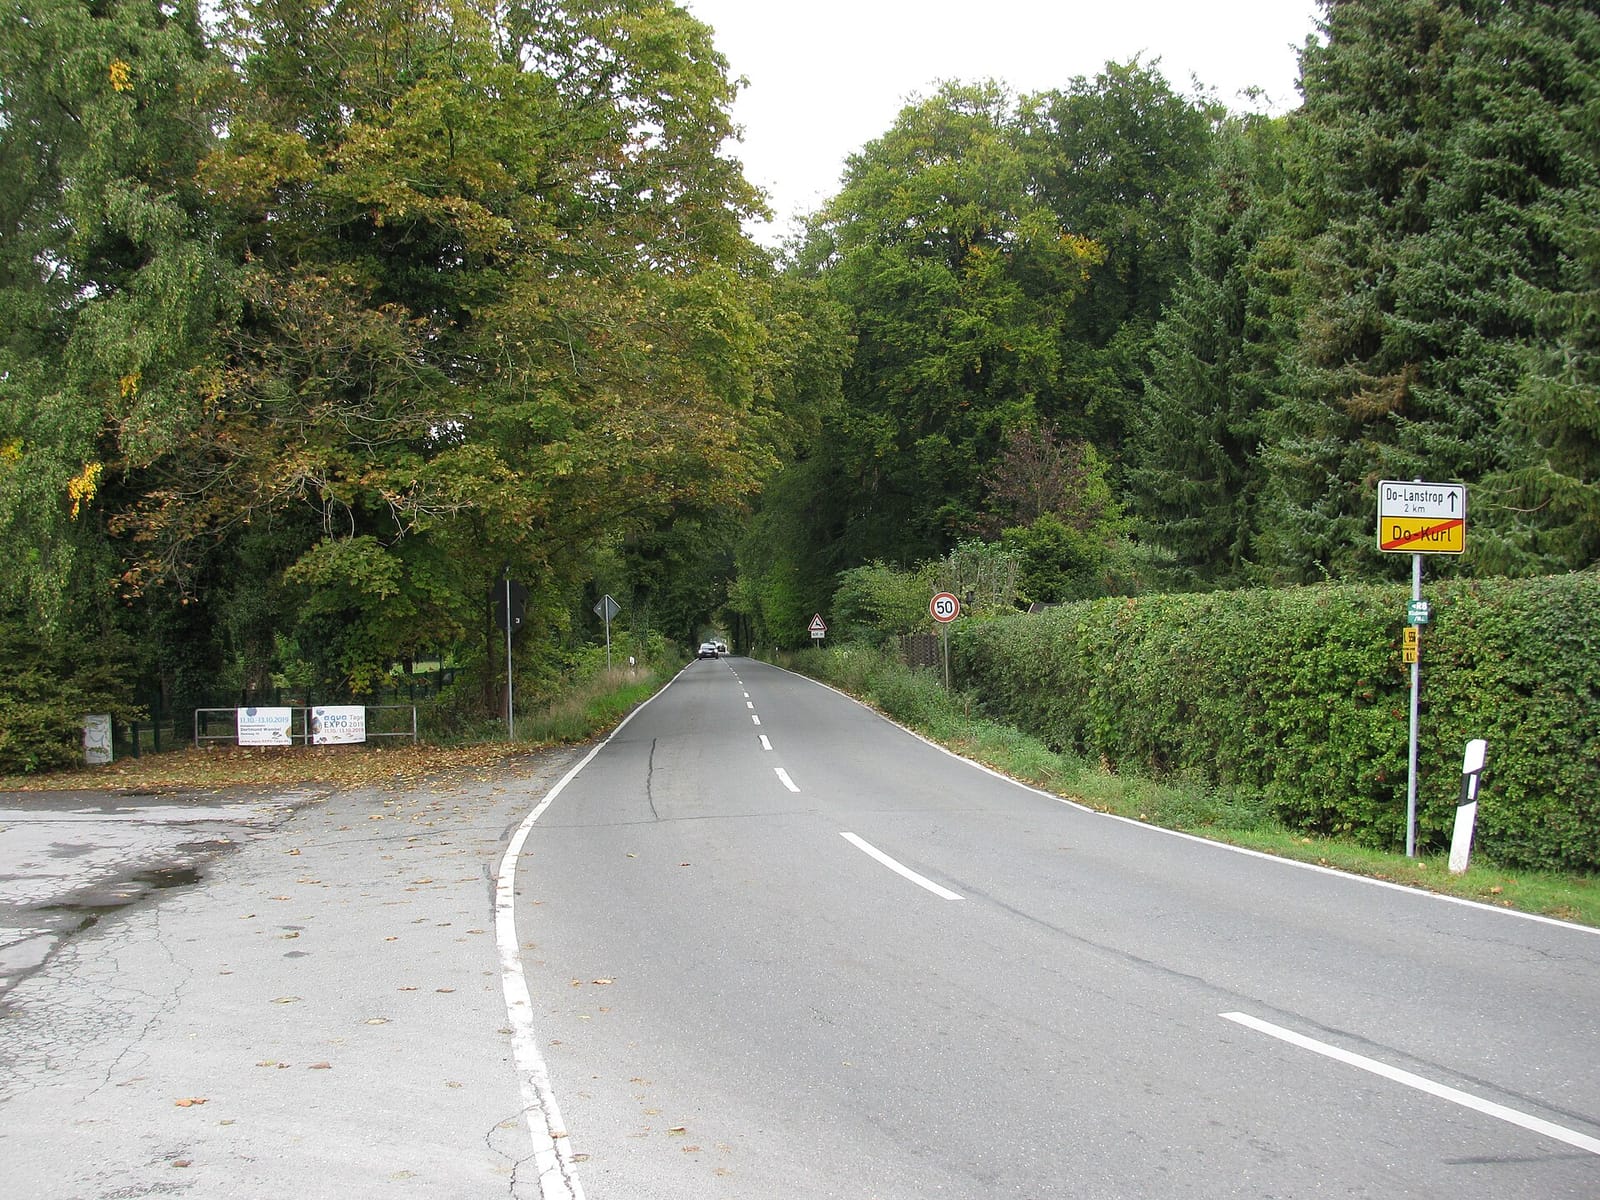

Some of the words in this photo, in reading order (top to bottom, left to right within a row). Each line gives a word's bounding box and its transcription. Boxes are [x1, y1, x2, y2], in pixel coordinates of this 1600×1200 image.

[1386, 487, 1443, 505] Do-Lanstrop
[1404, 503, 1409, 513] 2
[1412, 504, 1426, 513] km
[1392, 525, 1452, 542] Do-Kurl
[936, 600, 953, 615] 50
[323, 715, 347, 723] aqua
[324, 720, 348, 728] EXPO
